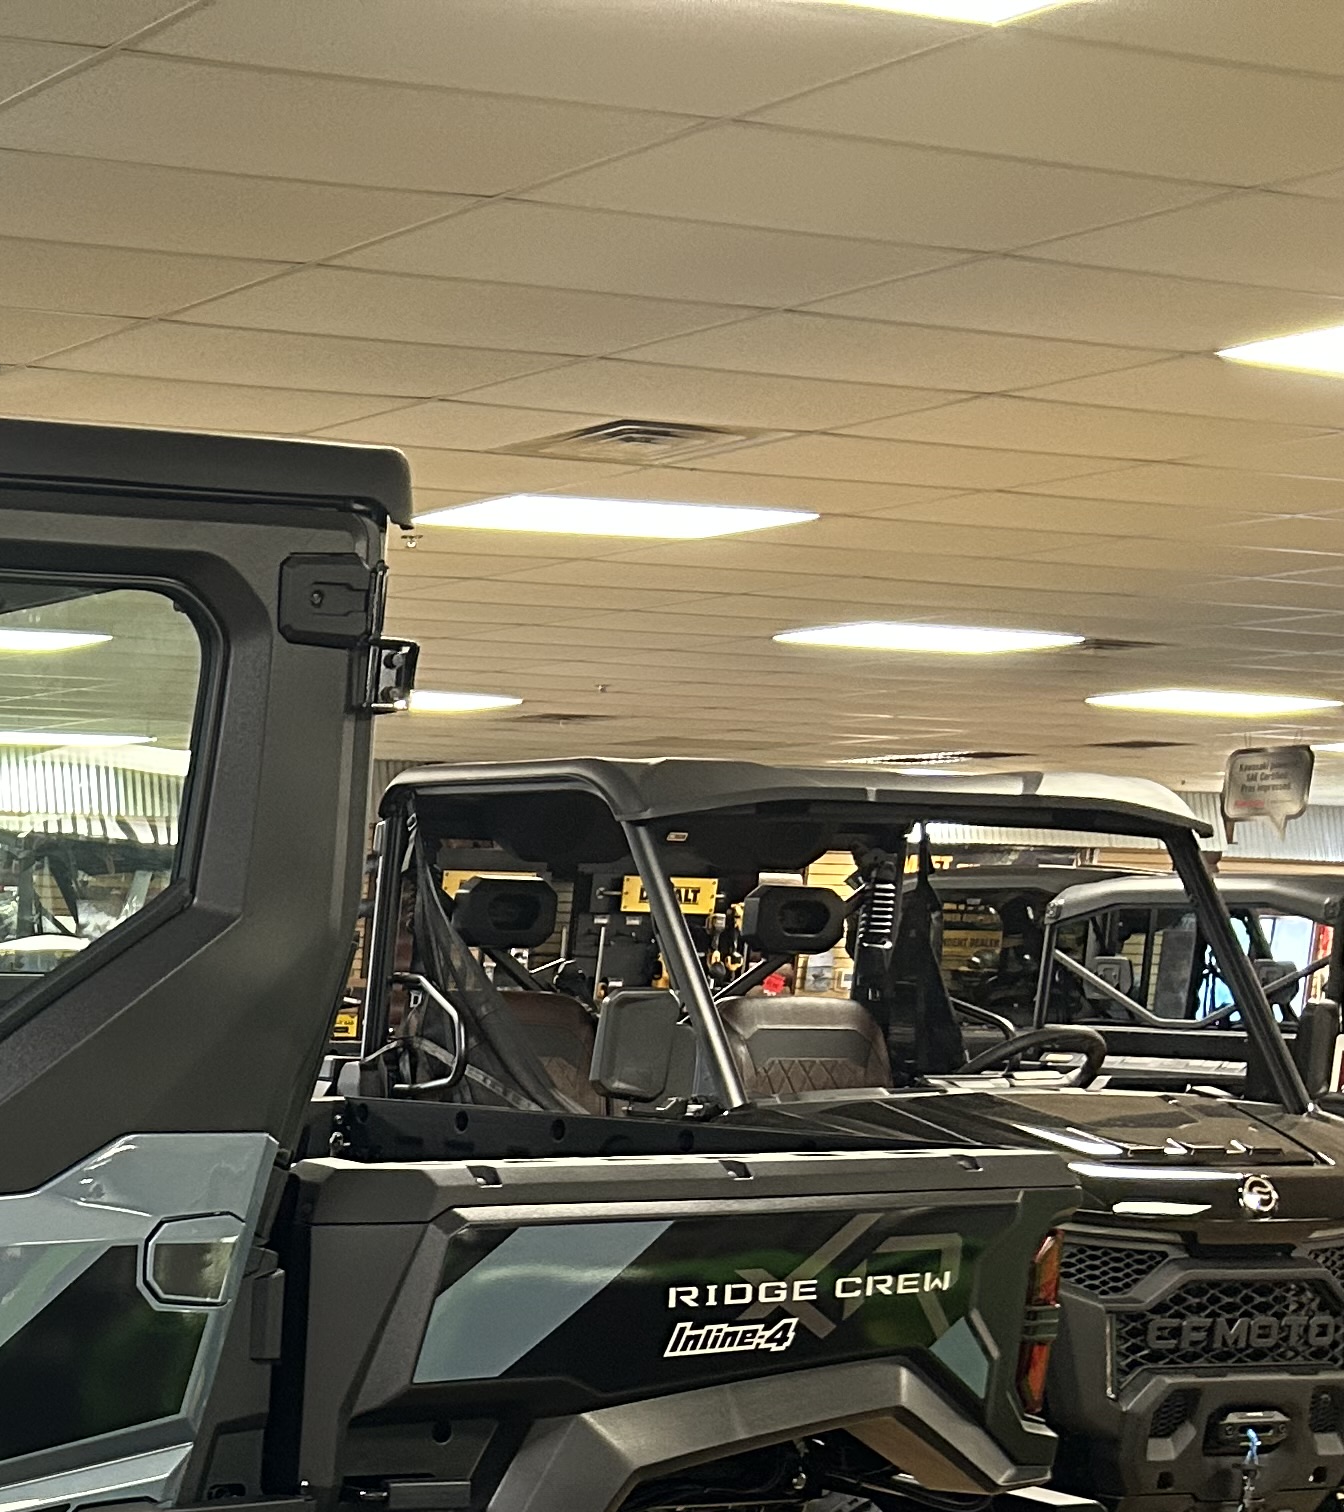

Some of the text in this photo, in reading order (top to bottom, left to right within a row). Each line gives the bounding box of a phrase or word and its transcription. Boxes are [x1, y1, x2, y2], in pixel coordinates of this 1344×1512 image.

[668, 1270, 952, 1308] RIDGE CREW
[1146, 1315, 1336, 1349] CFMOTO
